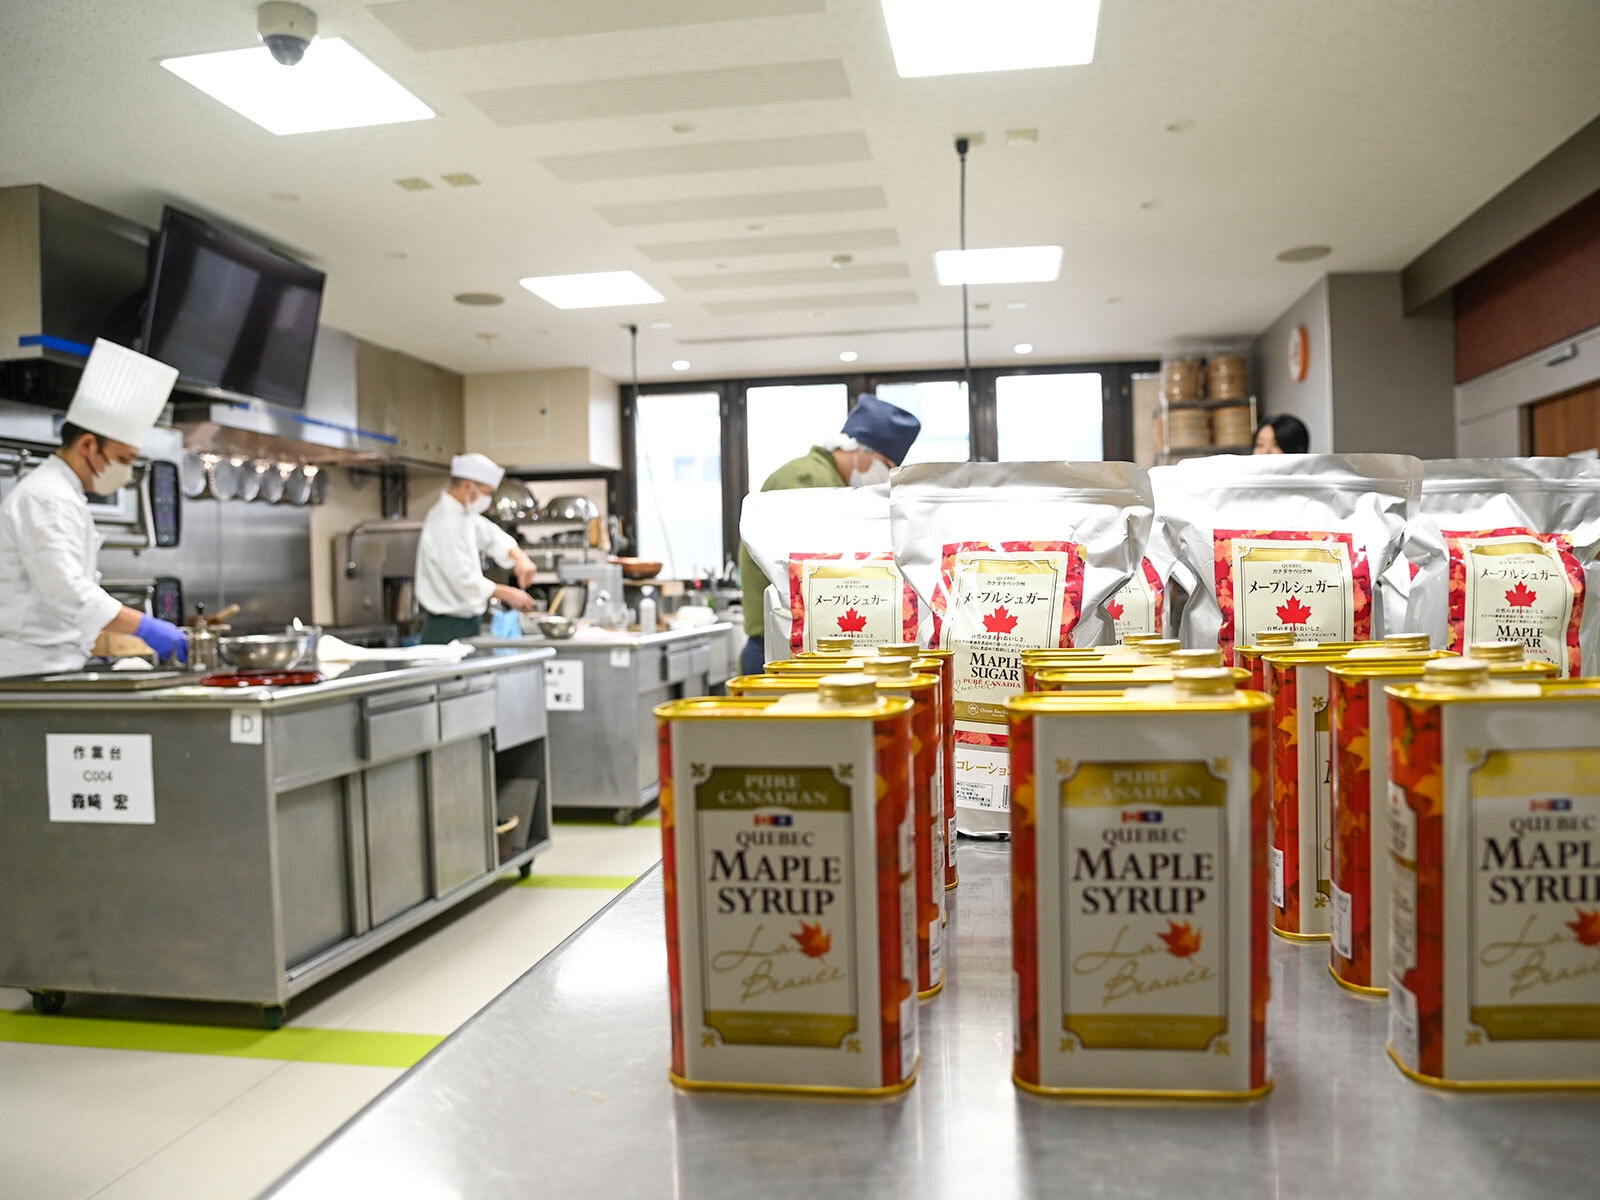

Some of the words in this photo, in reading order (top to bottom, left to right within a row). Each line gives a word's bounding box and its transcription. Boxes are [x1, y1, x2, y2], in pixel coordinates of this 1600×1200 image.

[1248, 579, 1339, 594] メープルシュガー
[814, 594, 889, 607] メープルシュガー
[1495, 624, 1544, 638] MAPLE
[969, 652, 1022, 669] MAPLE
[970, 666, 1020, 681] SUGAR
[985, 680, 1022, 688] CANADIA
[240, 715, 254, 734] D
[745, 774, 800, 789] PURE
[1112, 769, 1169, 785] PURE
[717, 790, 828, 805] CANADIAN
[1084, 785, 1202, 800] CANADIAN
[1509, 815, 1596, 837] QUEBEC
[735, 830, 815, 847] QUEBEC
[1101, 827, 1187, 847] QUEBEC
[1480, 836, 1600, 872] MAPL
[708, 849, 842, 884] MAPLE
[1072, 847, 1214, 882] MAPLE
[717, 886, 835, 916] SYRUP
[1081, 885, 1206, 915] SYRUP
[711, 924, 794, 973] La
[1072, 923, 1158, 976] La
